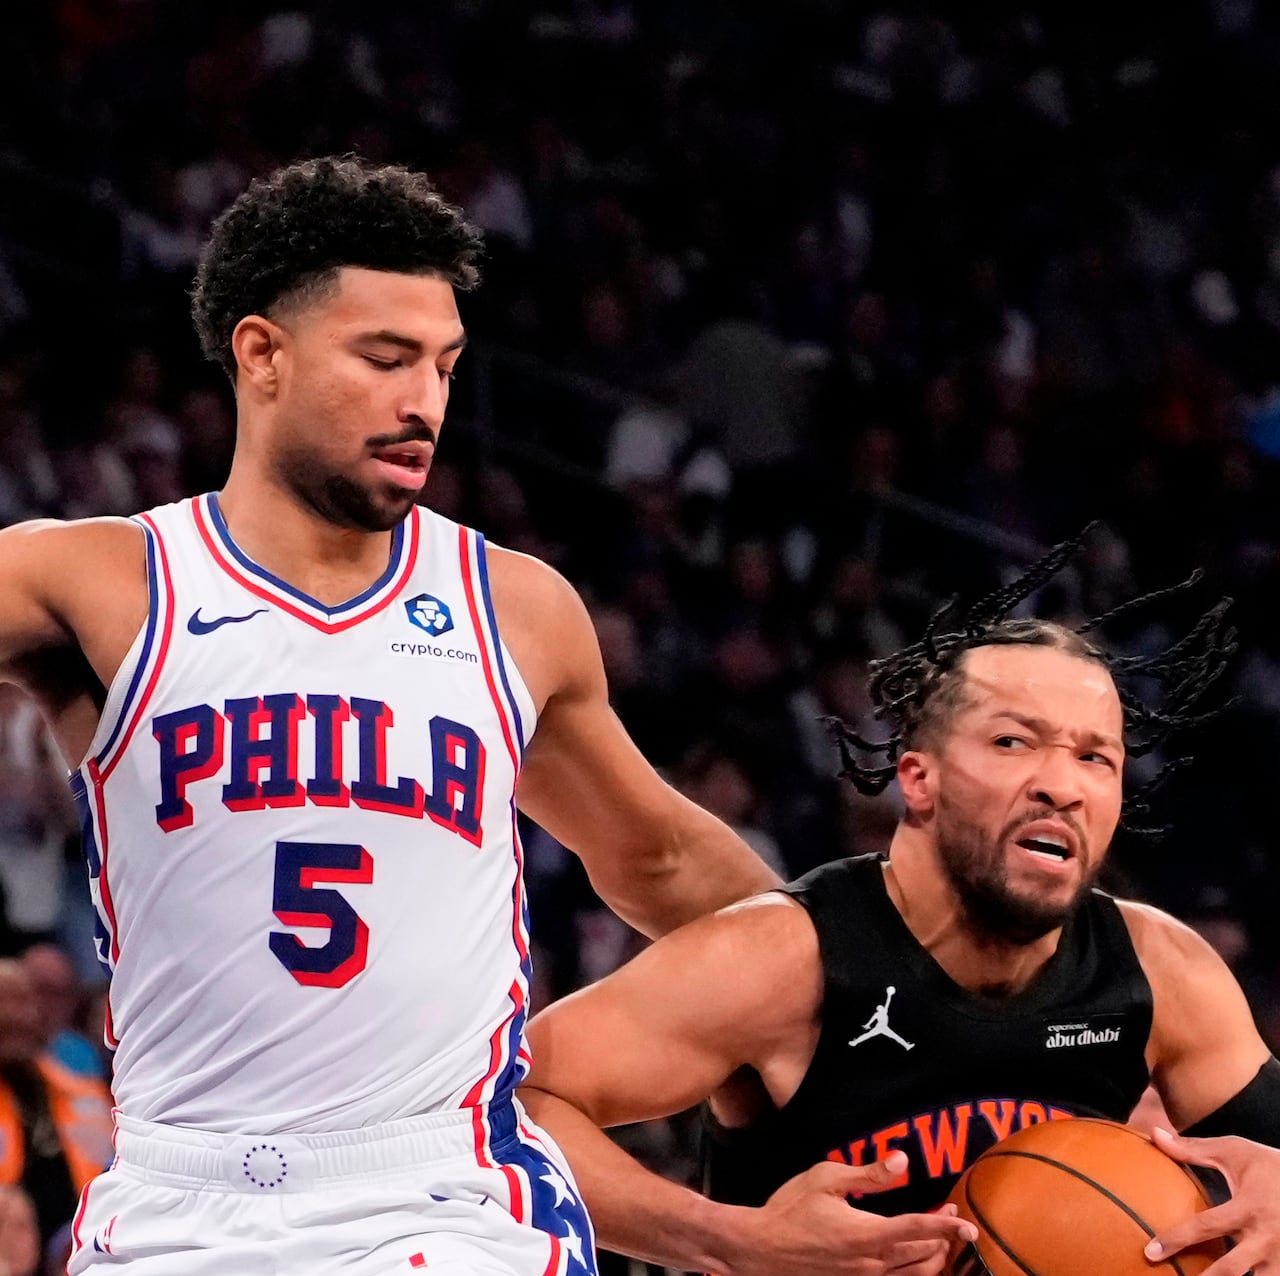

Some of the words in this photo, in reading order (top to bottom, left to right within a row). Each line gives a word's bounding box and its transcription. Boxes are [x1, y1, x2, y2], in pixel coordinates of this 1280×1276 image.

[391, 642, 478, 664] crypto.com
[152, 692, 487, 849] PHILA
[268, 841, 374, 989] 5
[1045, 1032, 1076, 1049] abu
[1076, 1026, 1122, 1046] dhabi
